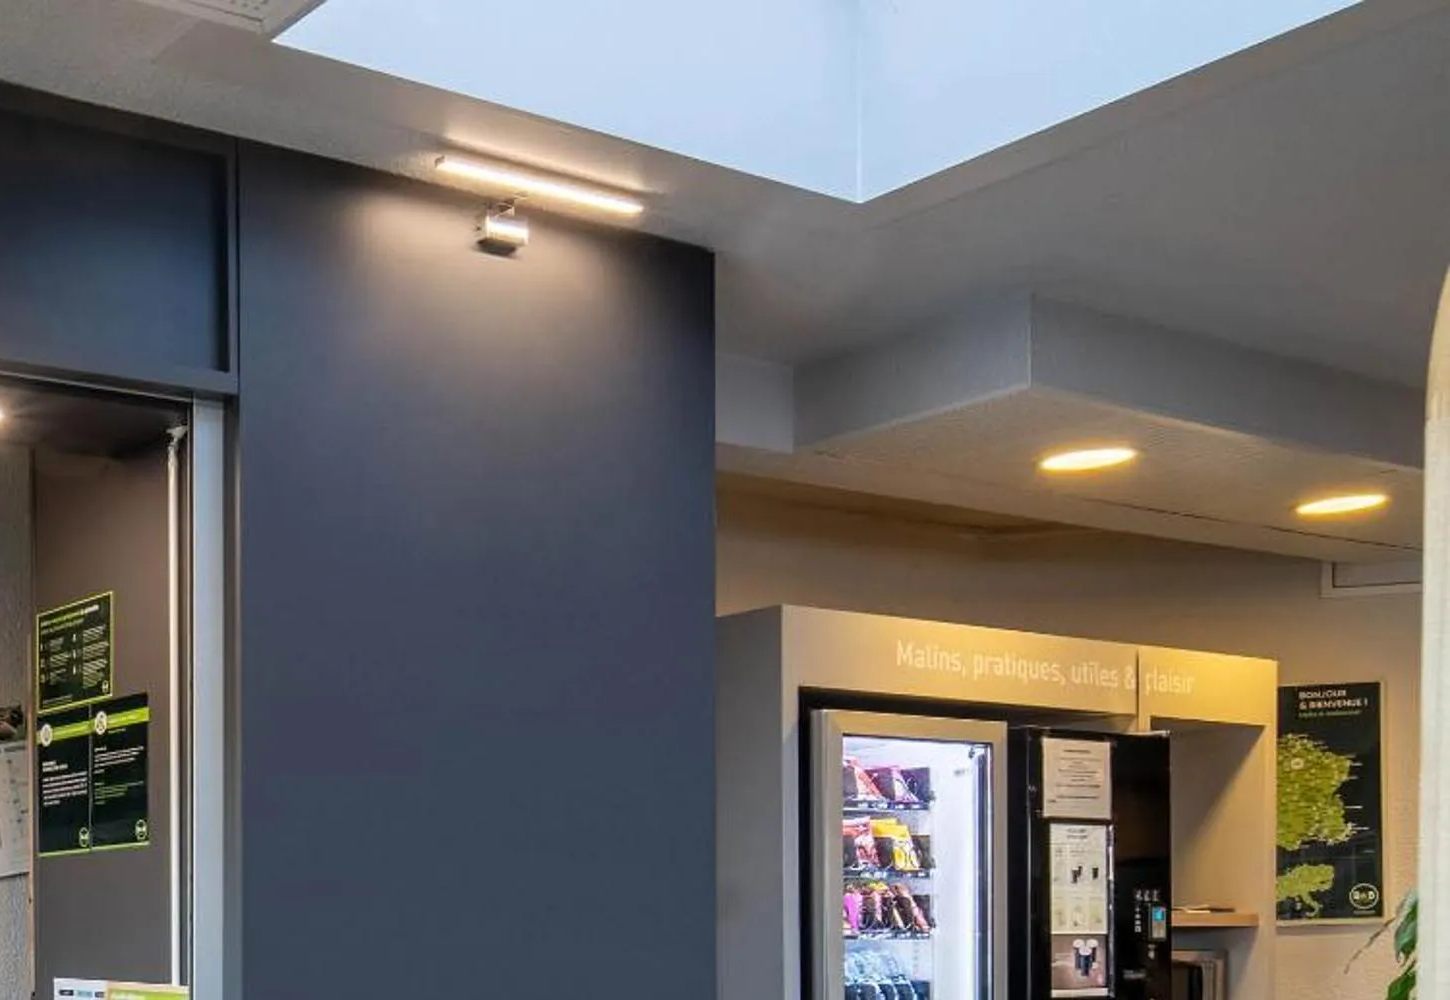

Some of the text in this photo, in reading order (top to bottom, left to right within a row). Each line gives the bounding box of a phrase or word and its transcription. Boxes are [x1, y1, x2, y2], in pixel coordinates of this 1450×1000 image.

[896, 638, 966, 679] Malins,
[972, 651, 1066, 685] pratiques,
[1071, 661, 1118, 688] utiles
[1298, 689, 1347, 699] BONJOUR
[1308, 698, 1362, 709] BIENVENUE
